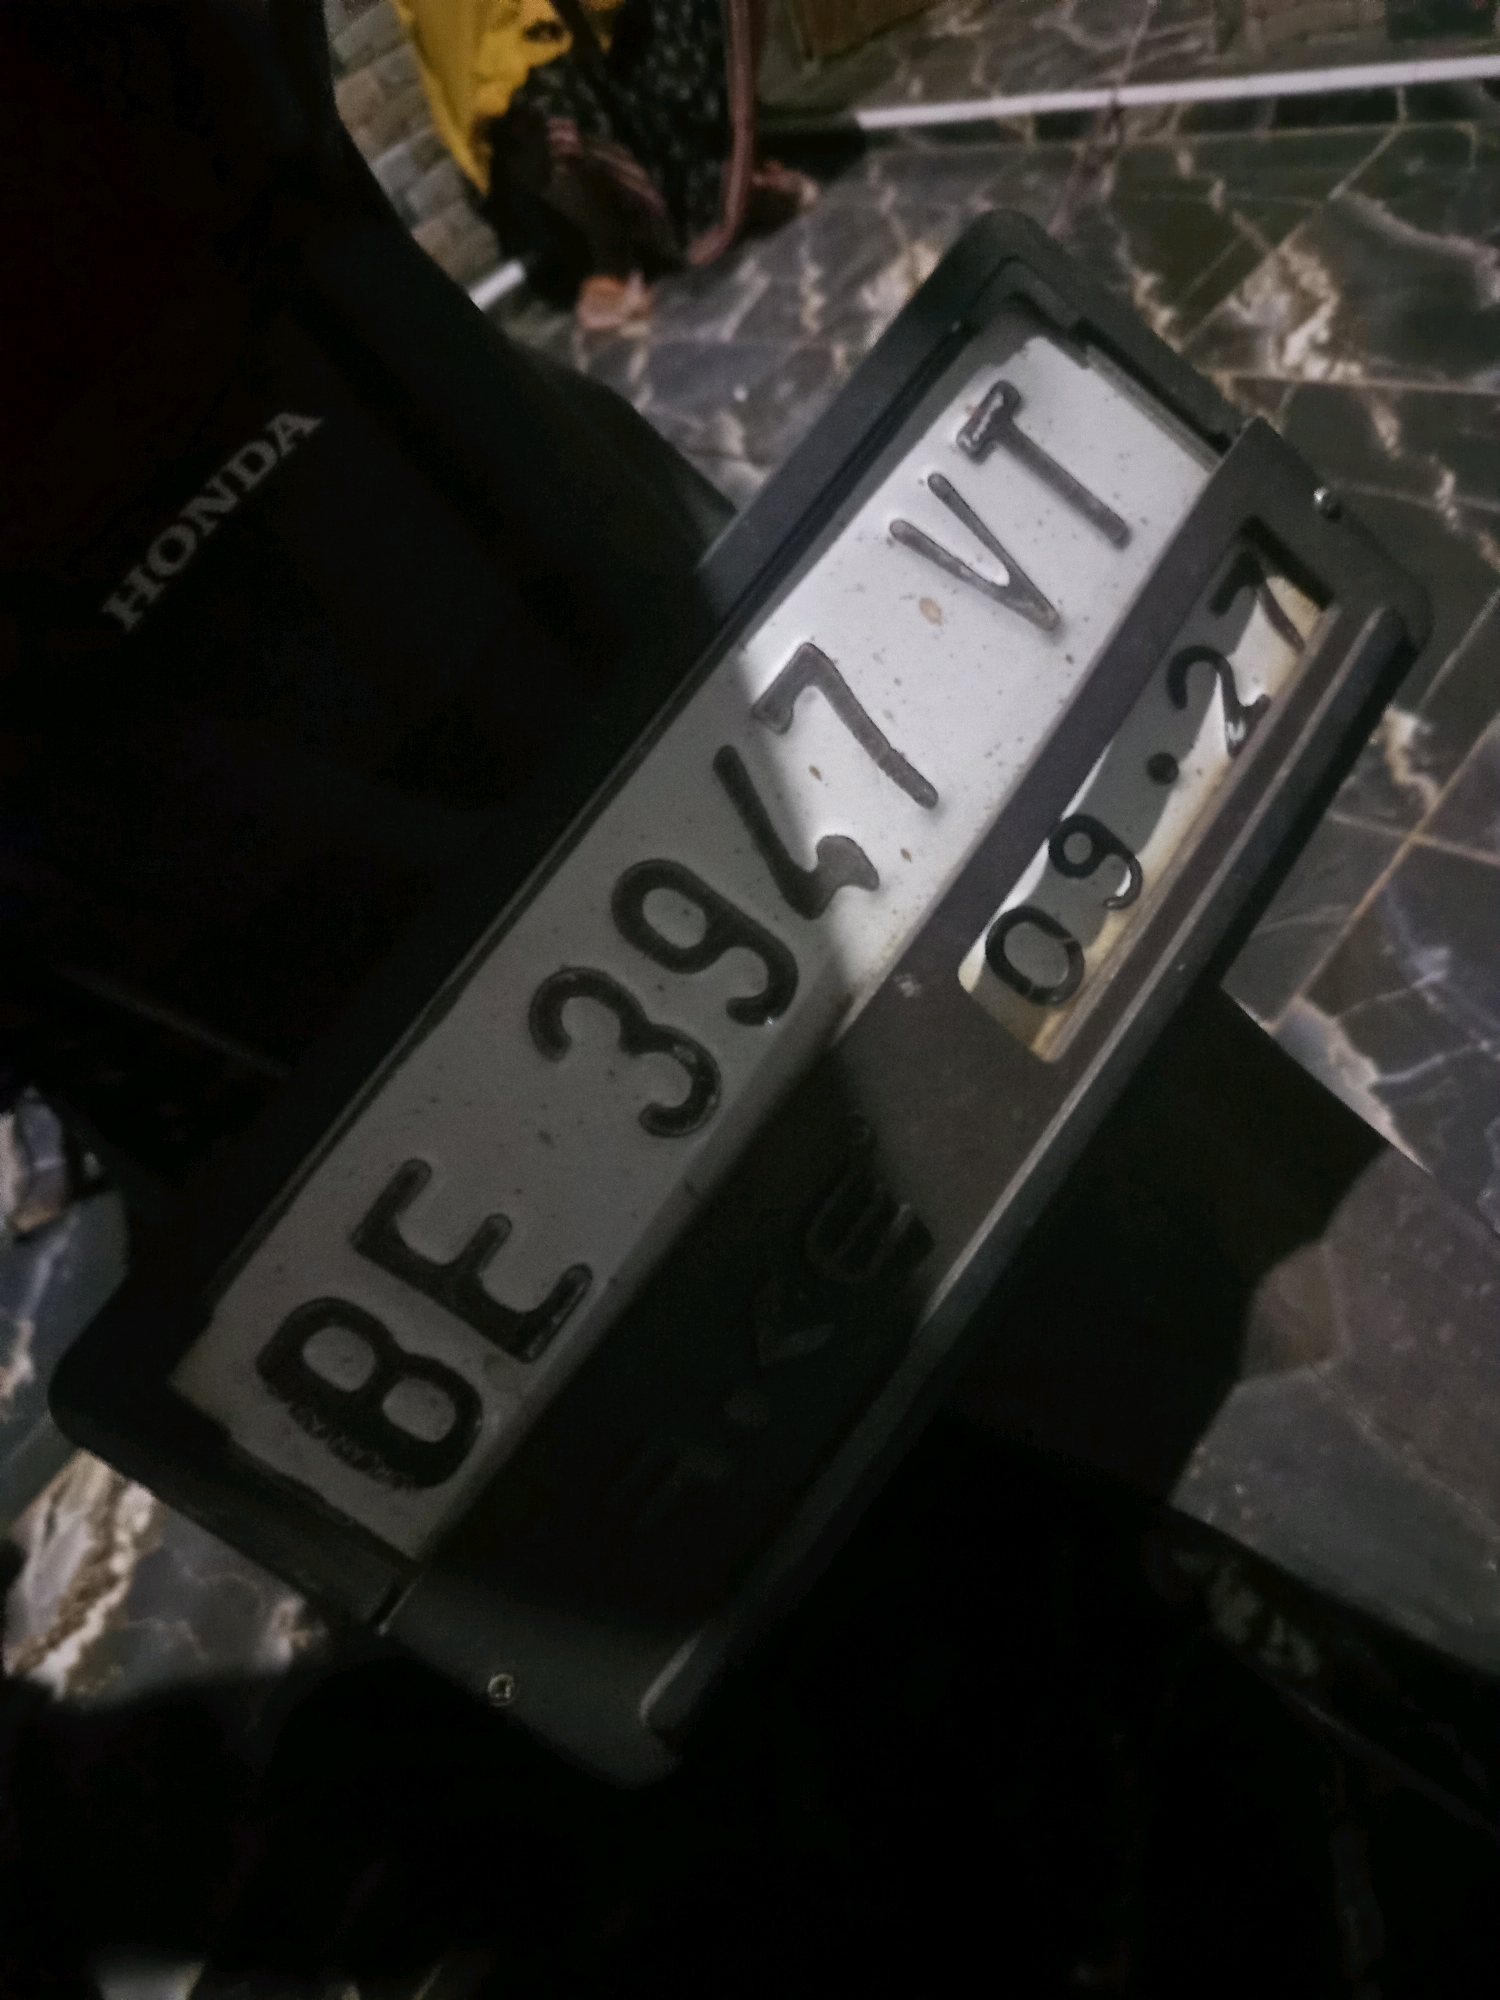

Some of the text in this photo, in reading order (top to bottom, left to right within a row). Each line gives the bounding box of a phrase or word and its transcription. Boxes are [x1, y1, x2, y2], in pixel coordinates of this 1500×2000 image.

[100, 411, 324, 635] HONDA
[256, 1158, 593, 1490] BE
[528, 642, 938, 1138] 3947
[889, 379, 1131, 636] VT
